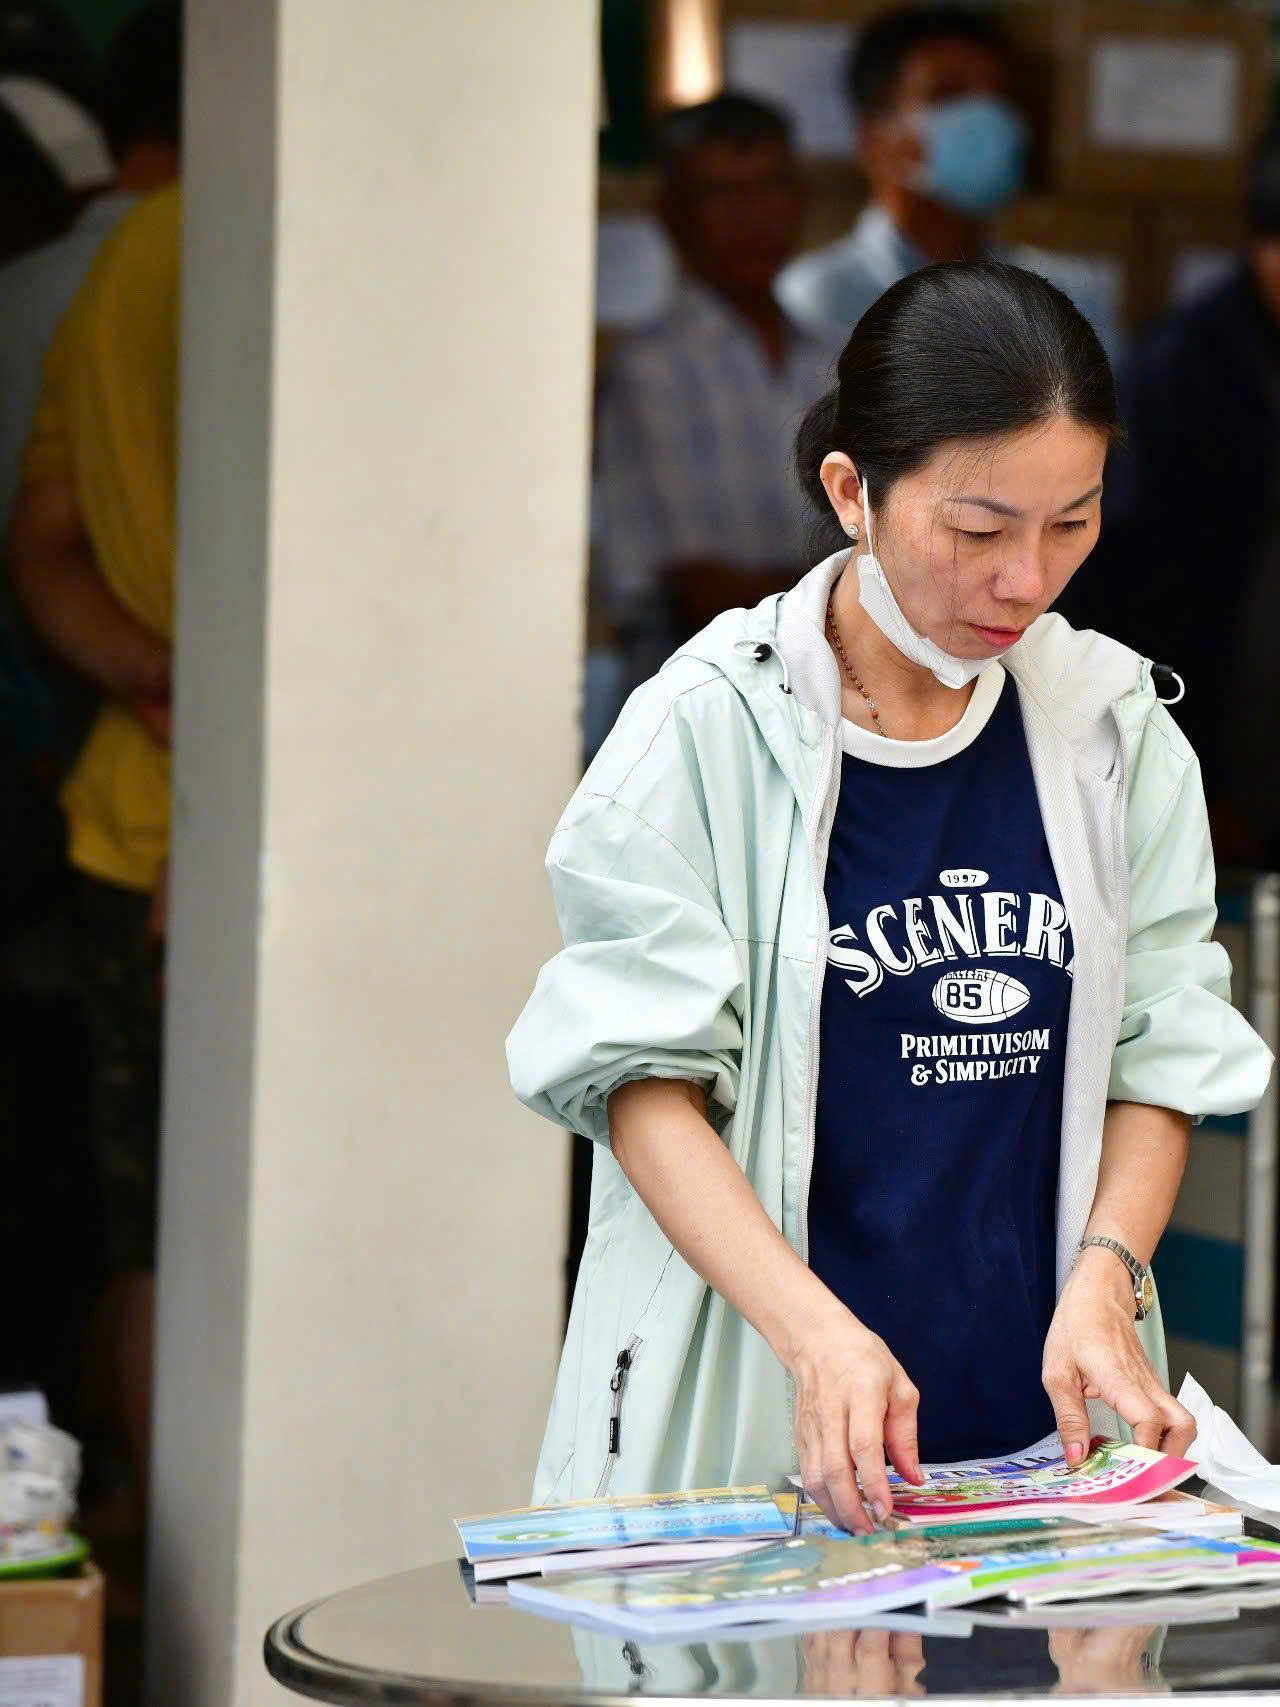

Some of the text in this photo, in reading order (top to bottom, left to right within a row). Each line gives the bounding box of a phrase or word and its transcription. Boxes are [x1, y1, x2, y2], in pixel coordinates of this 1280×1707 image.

[946, 874, 977, 884] 1997
[827, 891, 1074, 999] SCENER
[946, 983, 982, 1010] 85
[900, 1028, 1051, 1059] PRIMITIVISOM
[910, 1055, 1041, 1086] & SIMPLICITY
